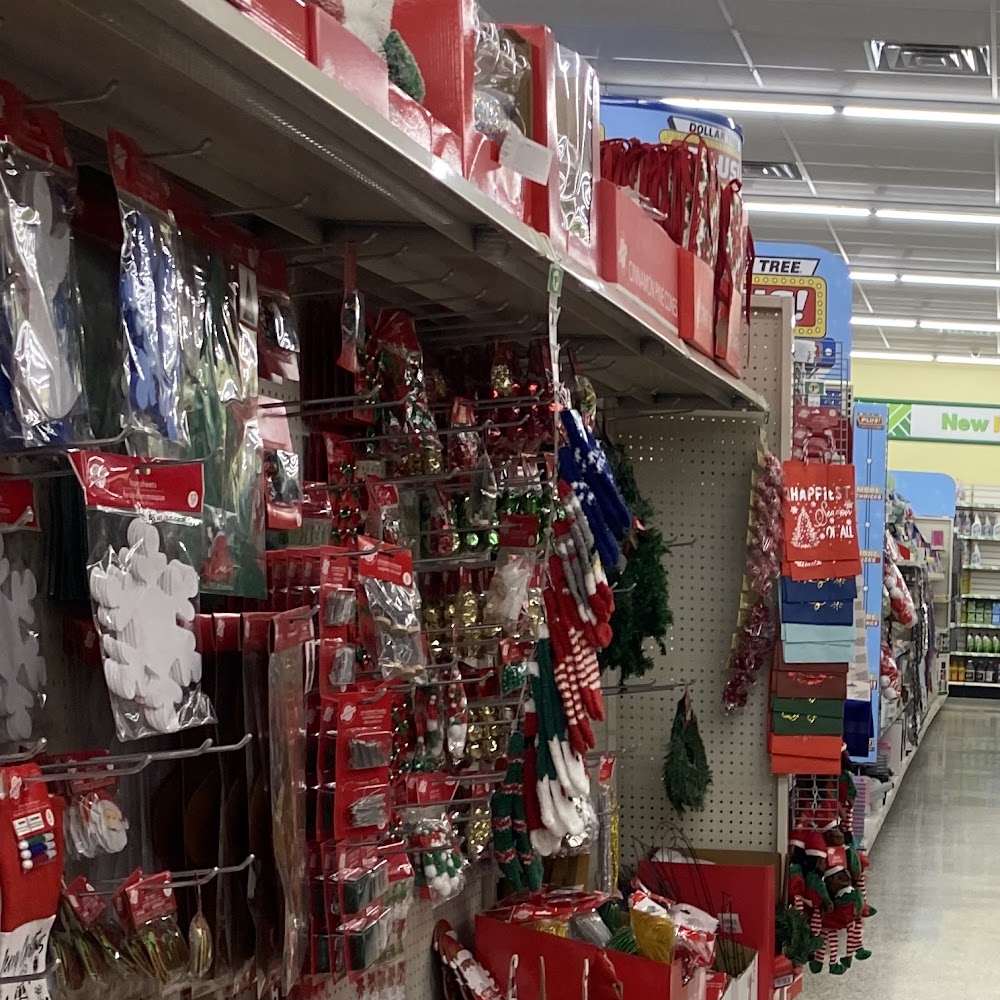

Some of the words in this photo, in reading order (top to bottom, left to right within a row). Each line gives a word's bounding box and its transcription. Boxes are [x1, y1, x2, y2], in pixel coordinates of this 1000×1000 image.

[688, 121, 726, 140] DOLLAR
[759, 259, 802, 274] TREE
[941, 412, 989, 433] New
[814, 501, 853, 529] Season
[840, 524, 854, 539] ALL
